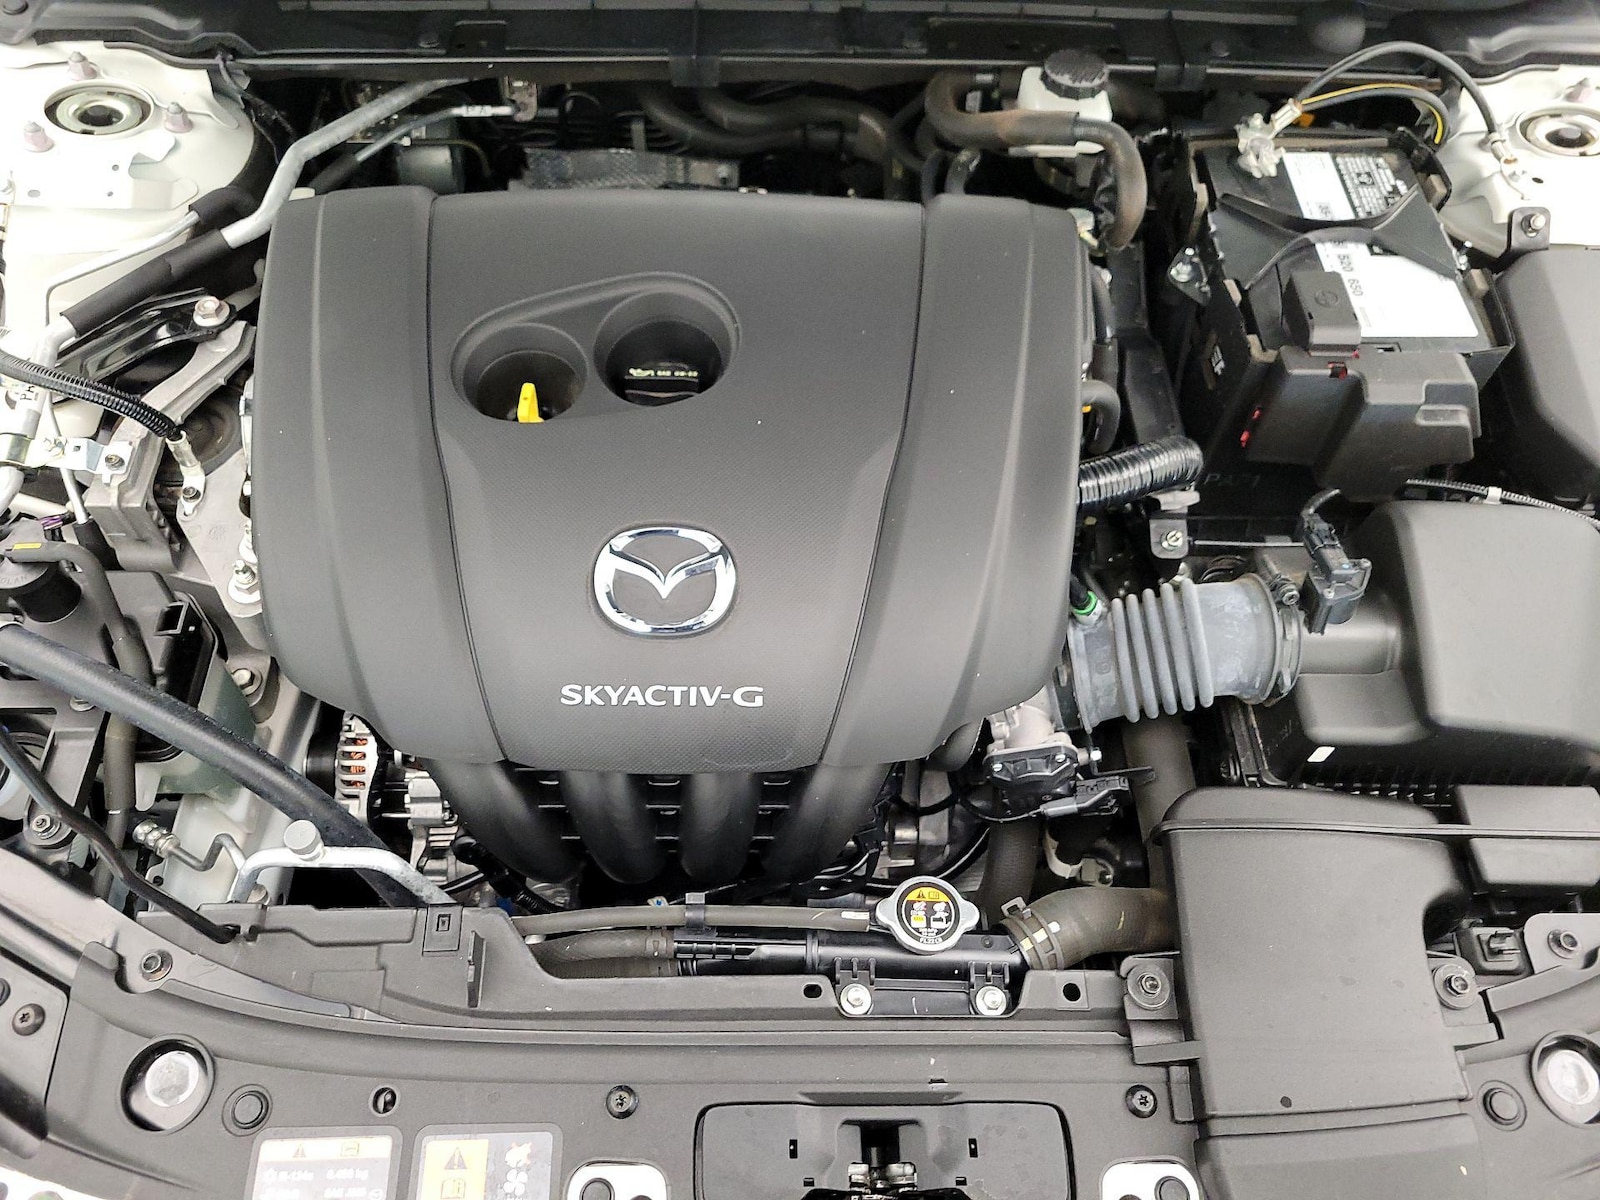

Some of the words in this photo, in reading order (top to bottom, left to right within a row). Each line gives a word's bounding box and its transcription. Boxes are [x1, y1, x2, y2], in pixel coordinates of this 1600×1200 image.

[1338, 253, 1354, 272] 520
[1348, 278, 1364, 296] 650
[560, 684, 764, 707] SKYACTIV-G
